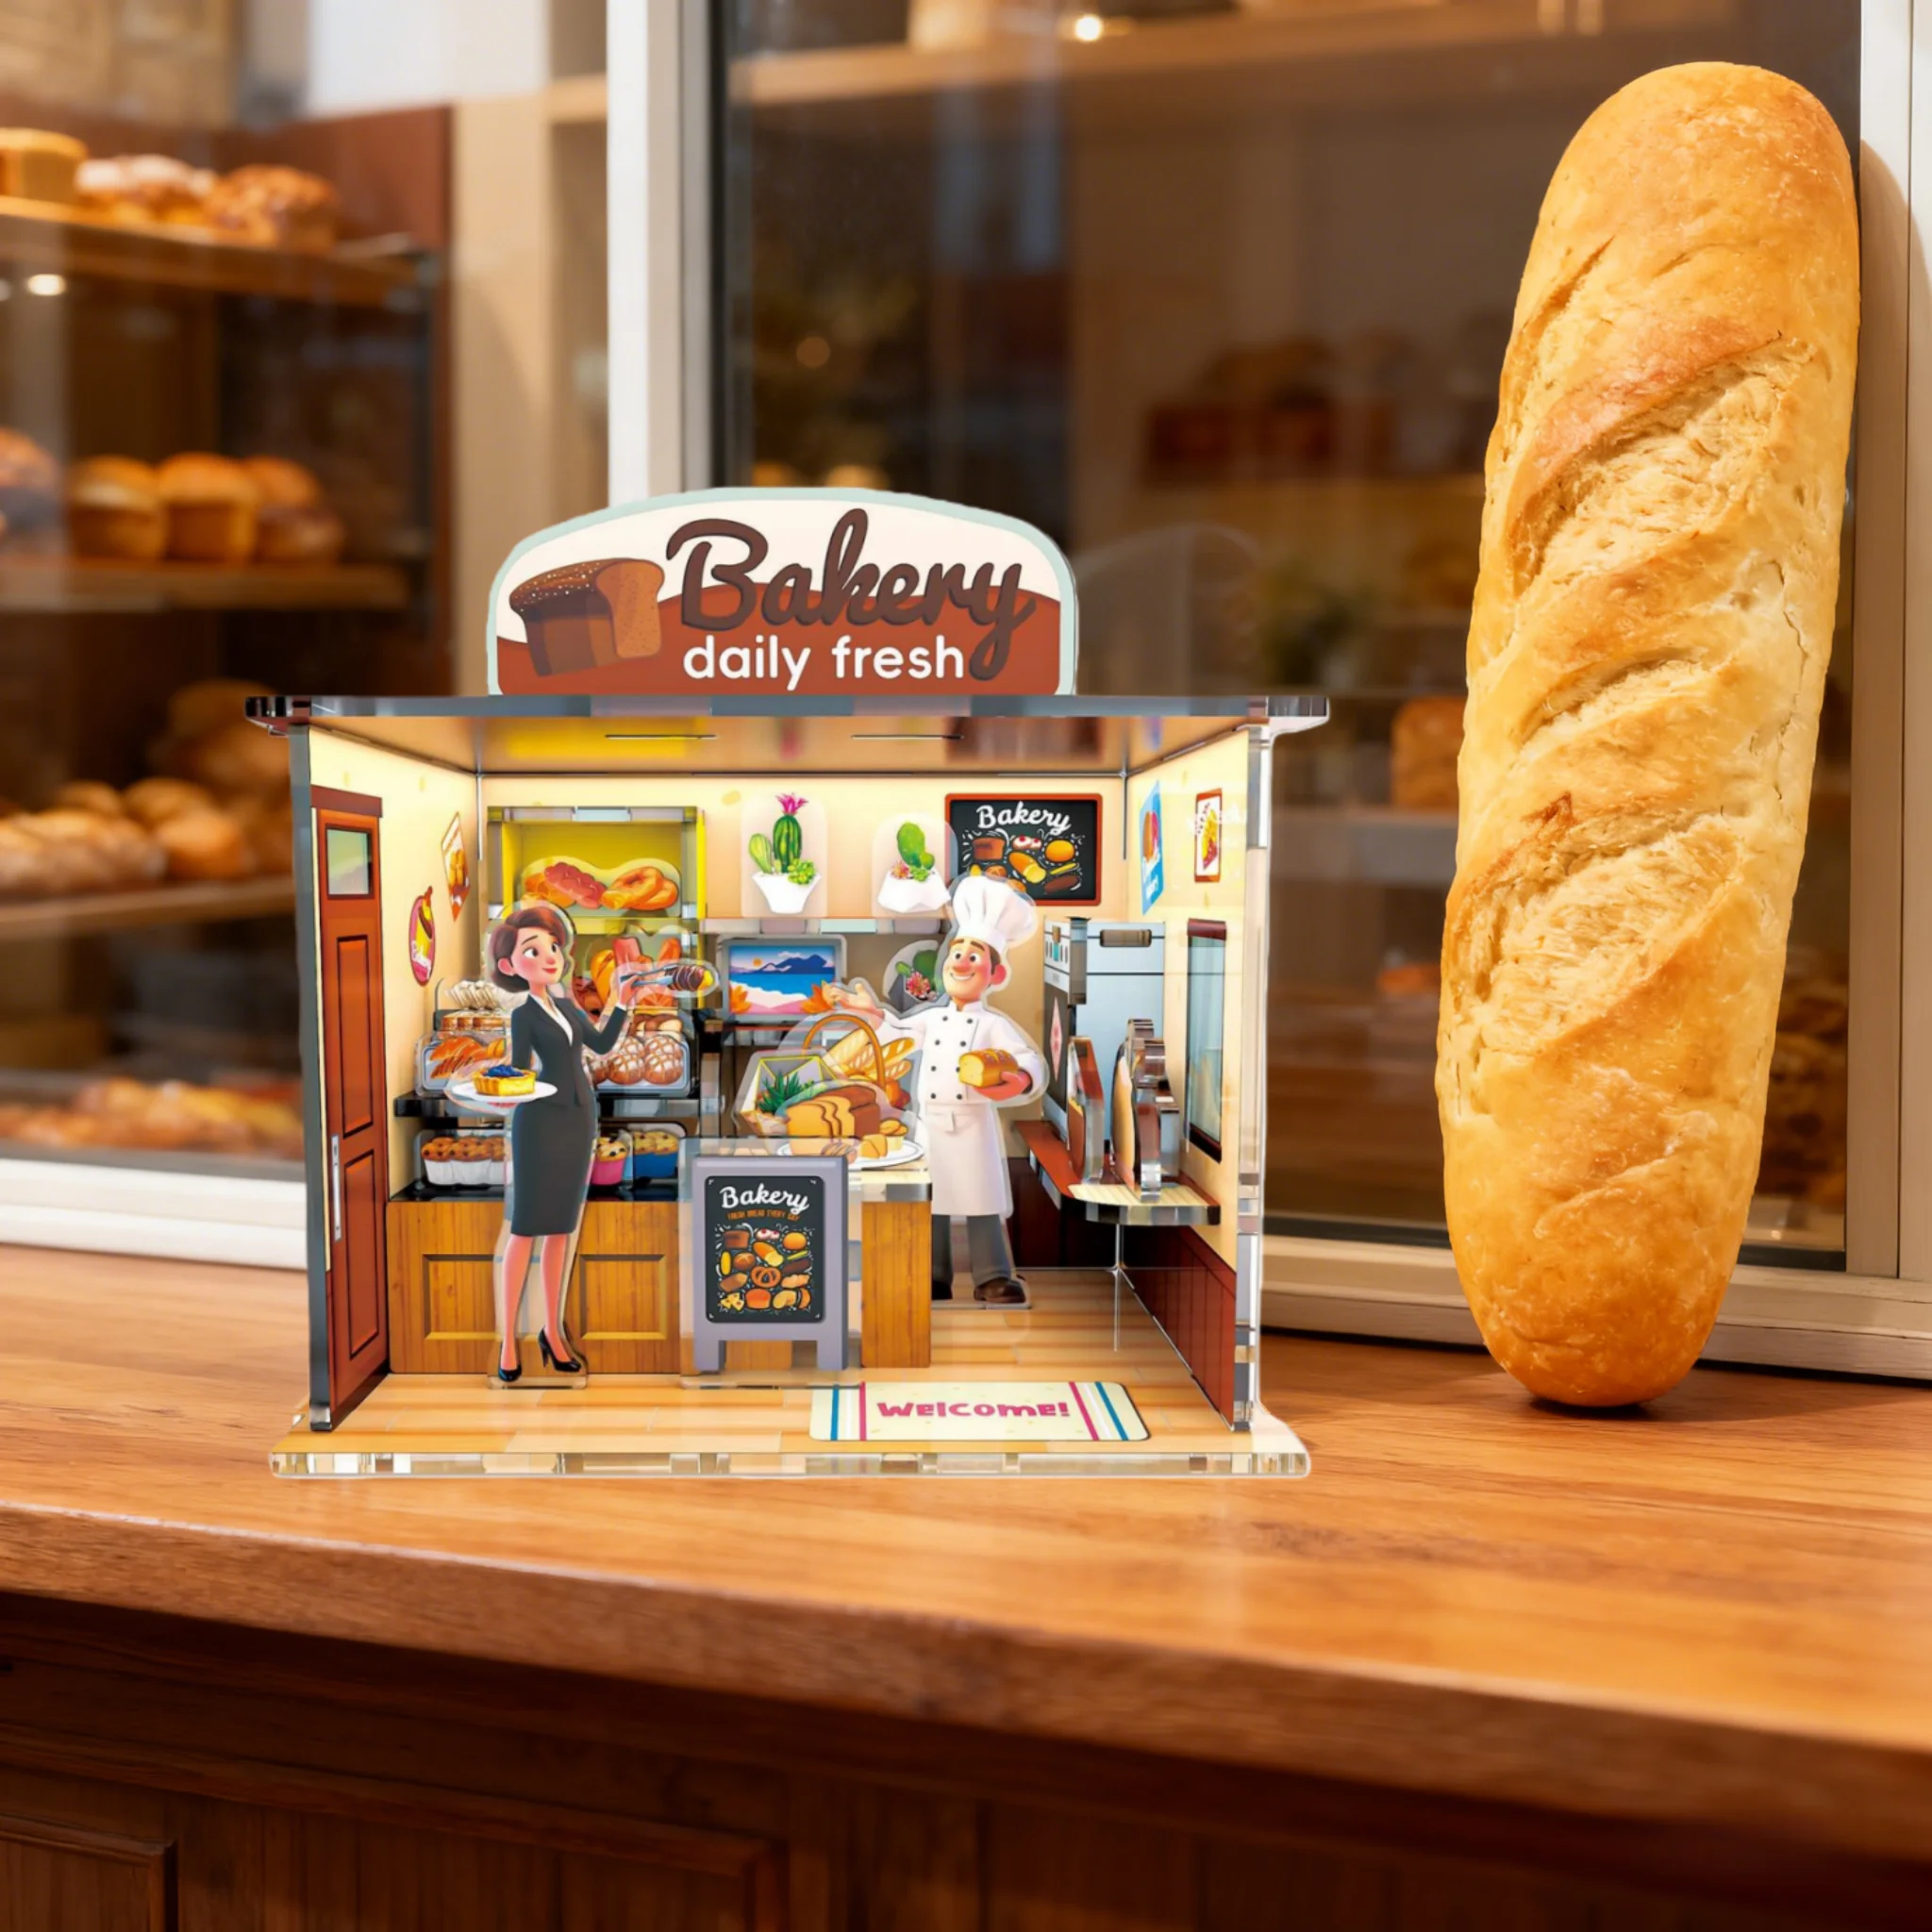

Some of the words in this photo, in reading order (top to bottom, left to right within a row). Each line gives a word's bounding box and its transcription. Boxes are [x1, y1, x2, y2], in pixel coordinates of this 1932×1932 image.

[666, 508, 1036, 681] Bakery
[683, 634, 811, 691] daily
[832, 634, 965, 679] fresh
[975, 801, 1072, 836] Bakery
[720, 1183, 810, 1215] Bakery
[876, 1402, 1070, 1418] Welcome!
